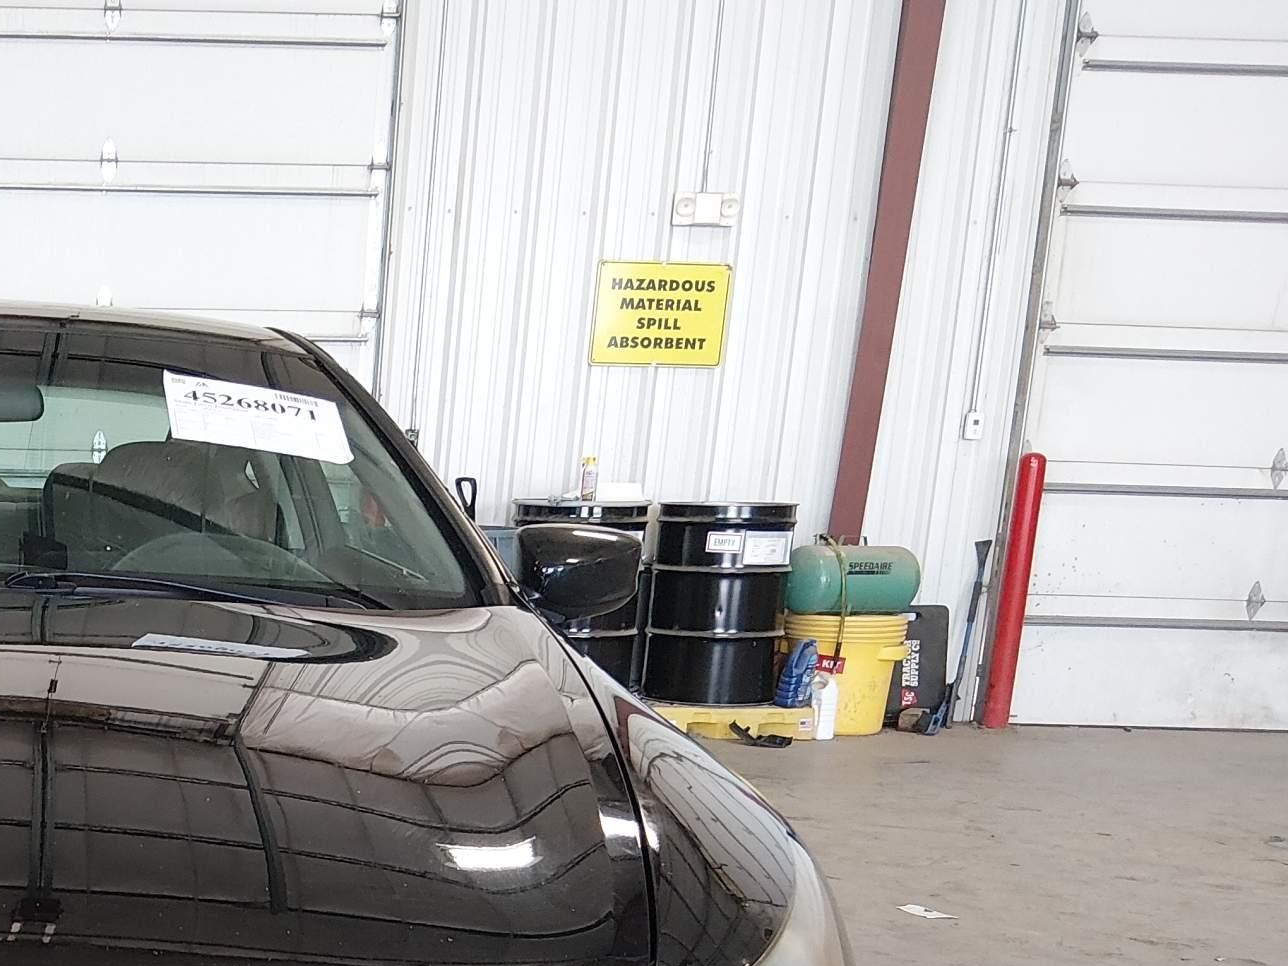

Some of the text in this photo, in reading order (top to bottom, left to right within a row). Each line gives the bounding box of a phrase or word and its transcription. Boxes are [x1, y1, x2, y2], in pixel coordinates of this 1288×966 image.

[611, 278, 716, 293] HAZARDOUS
[620, 297, 702, 311] MATERIAL
[636, 317, 681, 330] SPILL
[607, 336, 707, 350] ABSORBENT
[184, 390, 317, 421] 45268071
[848, 561, 893, 570] SPEEDAIRE
[910, 652, 920, 687] SUPPLY
